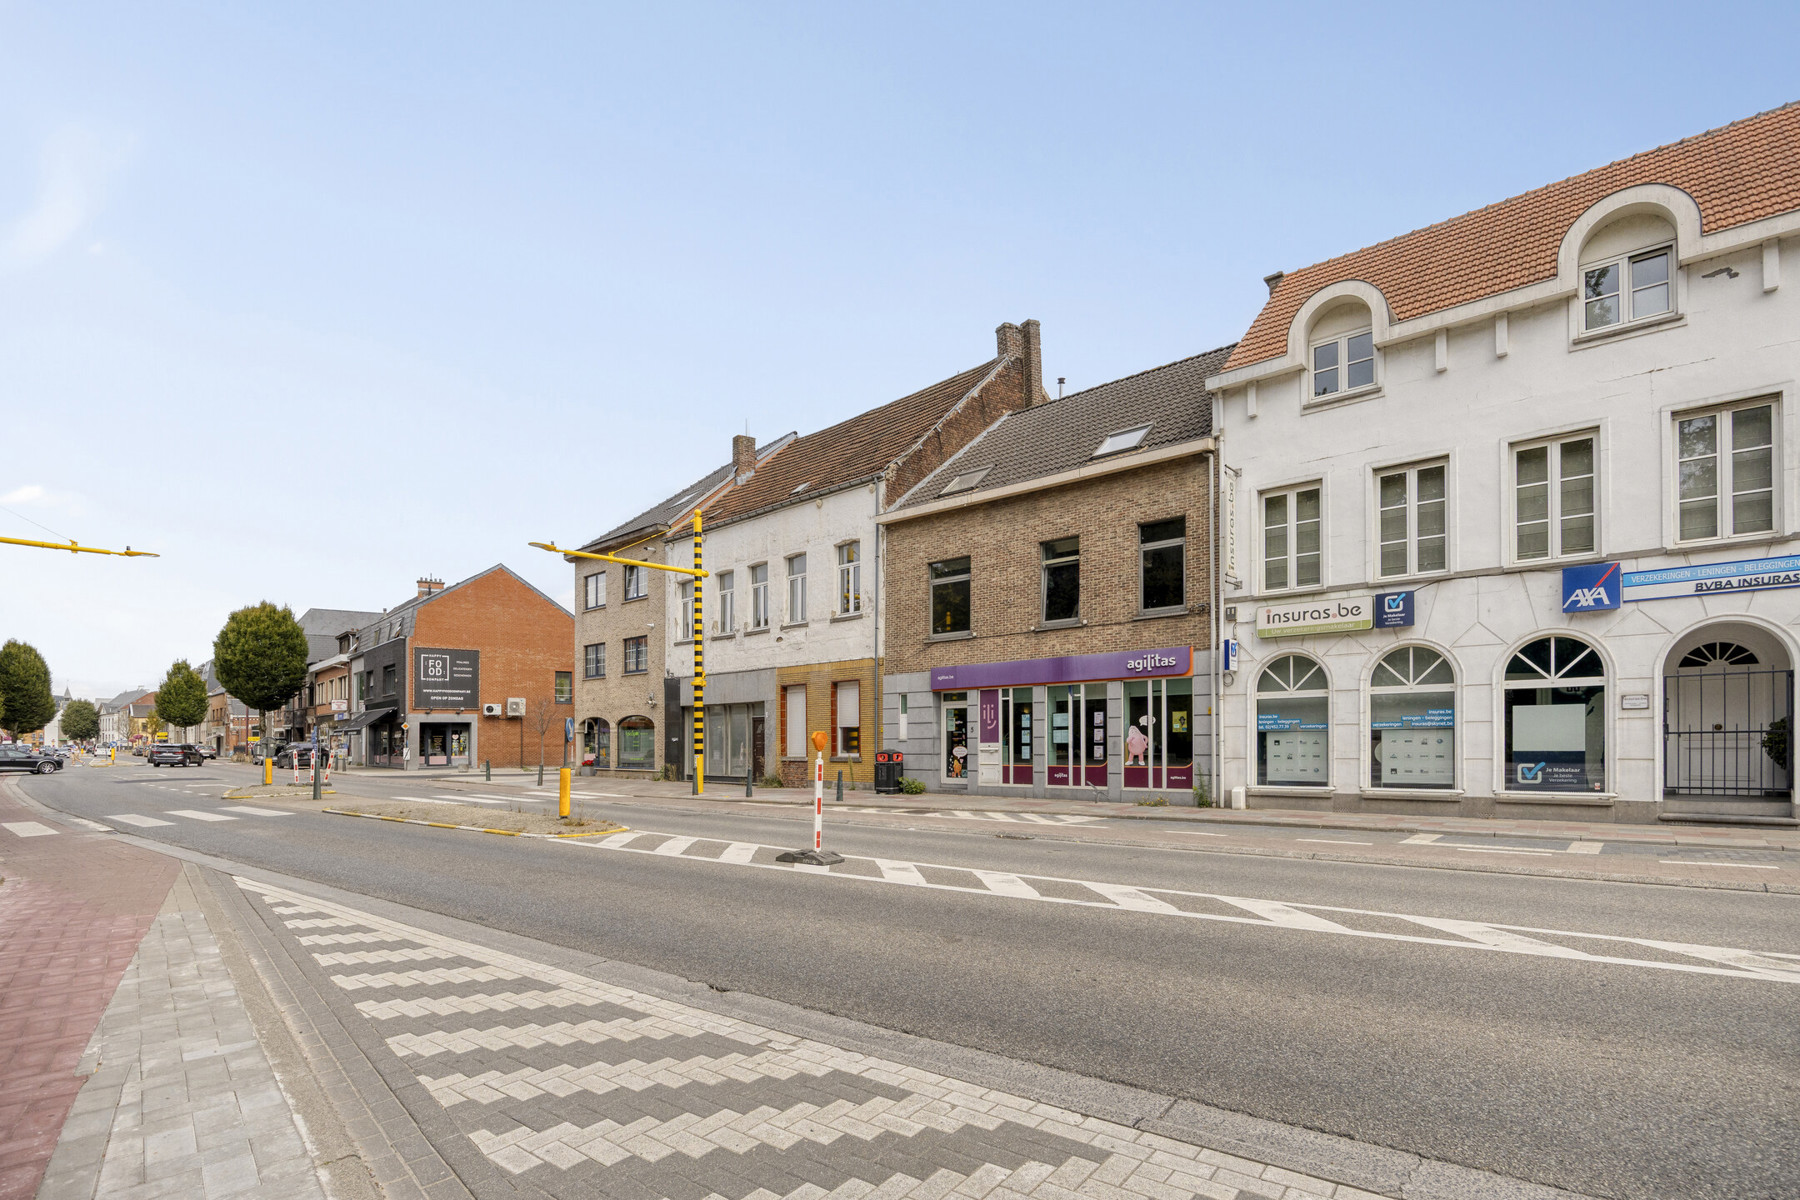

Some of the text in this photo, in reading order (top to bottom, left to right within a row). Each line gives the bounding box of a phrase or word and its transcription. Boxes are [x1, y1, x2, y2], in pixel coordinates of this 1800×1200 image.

[1631, 570, 1691, 583] VERZEKERINGEN
[1697, 565, 1737, 577] LENINGEN
[1744, 559, 1800, 572] BELEGGINGEN
[1694, 573, 1800, 592] BVBA INSURAS
[1563, 586, 1610, 608] AXA
[1266, 603, 1362, 624] insuras.be
[1127, 654, 1176, 672] agilitas
